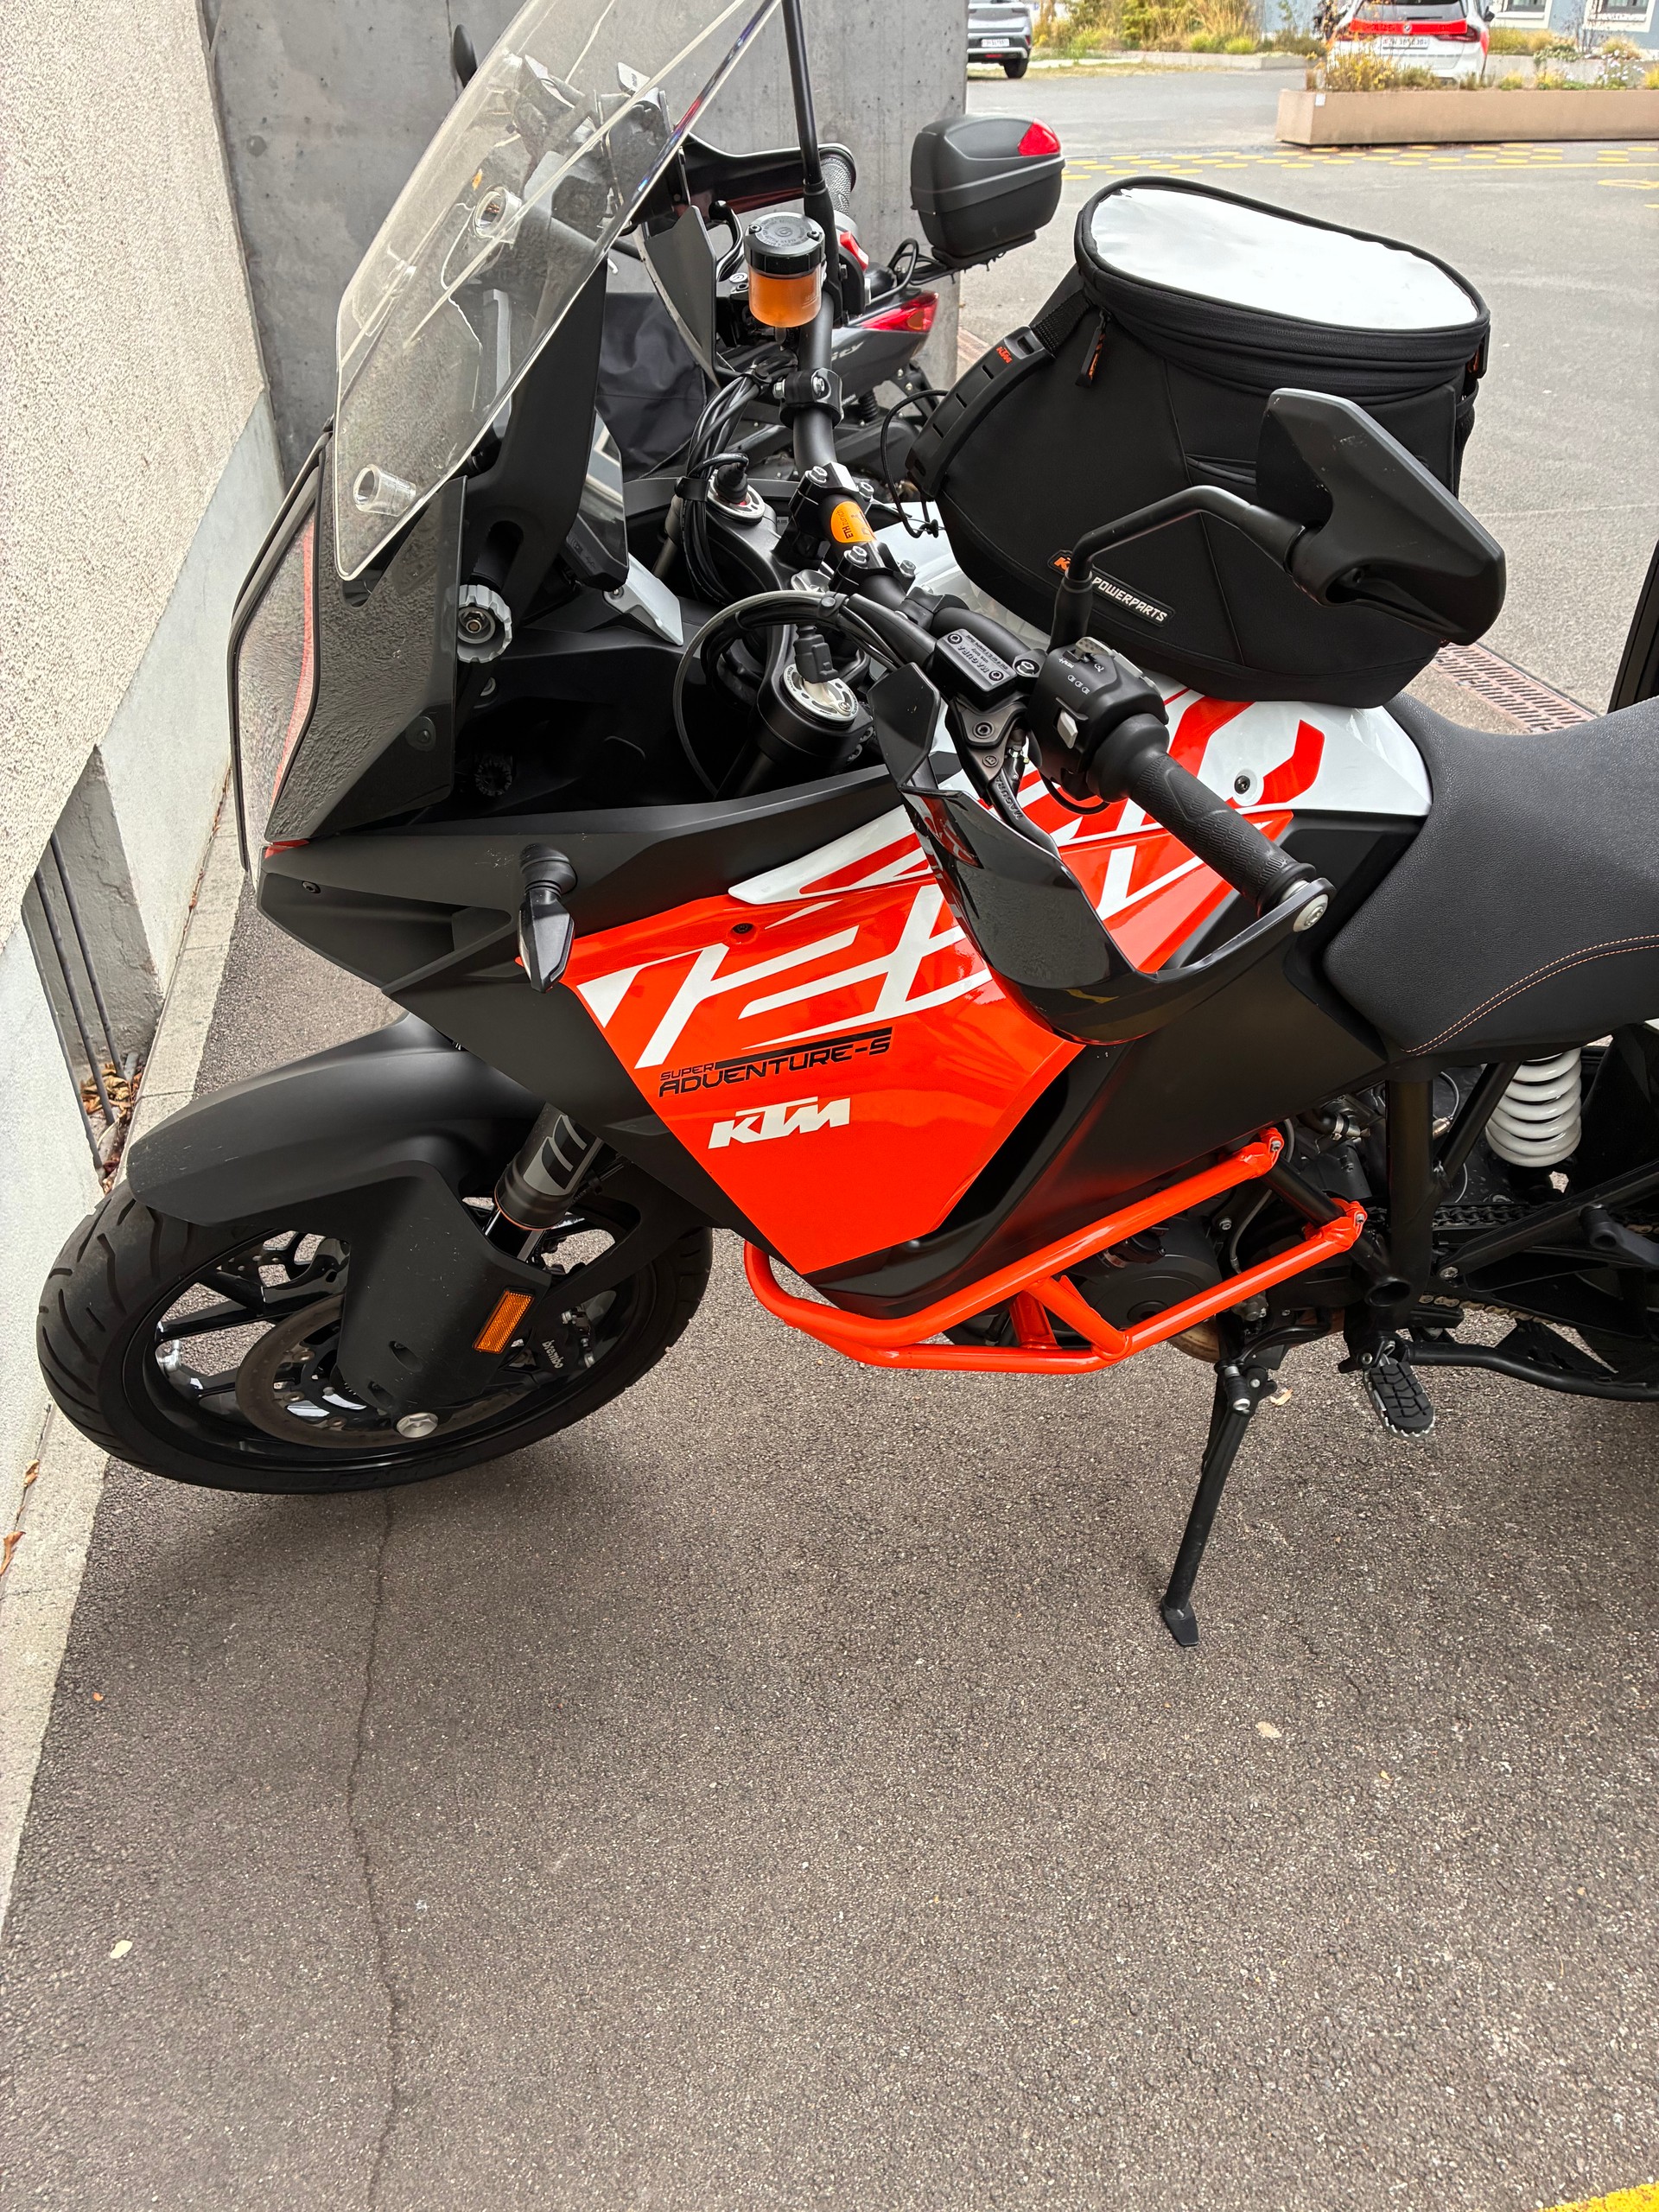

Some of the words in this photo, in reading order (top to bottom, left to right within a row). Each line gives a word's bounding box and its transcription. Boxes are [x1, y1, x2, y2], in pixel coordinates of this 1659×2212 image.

[842, 525, 854, 539] ETH
[1092, 576, 1167, 622] POWERPARTS
[957, 645, 990, 673] MAGURA
[995, 775, 1023, 820] MAGURA
[658, 1034, 893, 1098] ADVENTURE-S
[659, 1061, 715, 1081] SUPER
[708, 1096, 851, 1149] KTM
[542, 1339, 564, 1369] brembo
